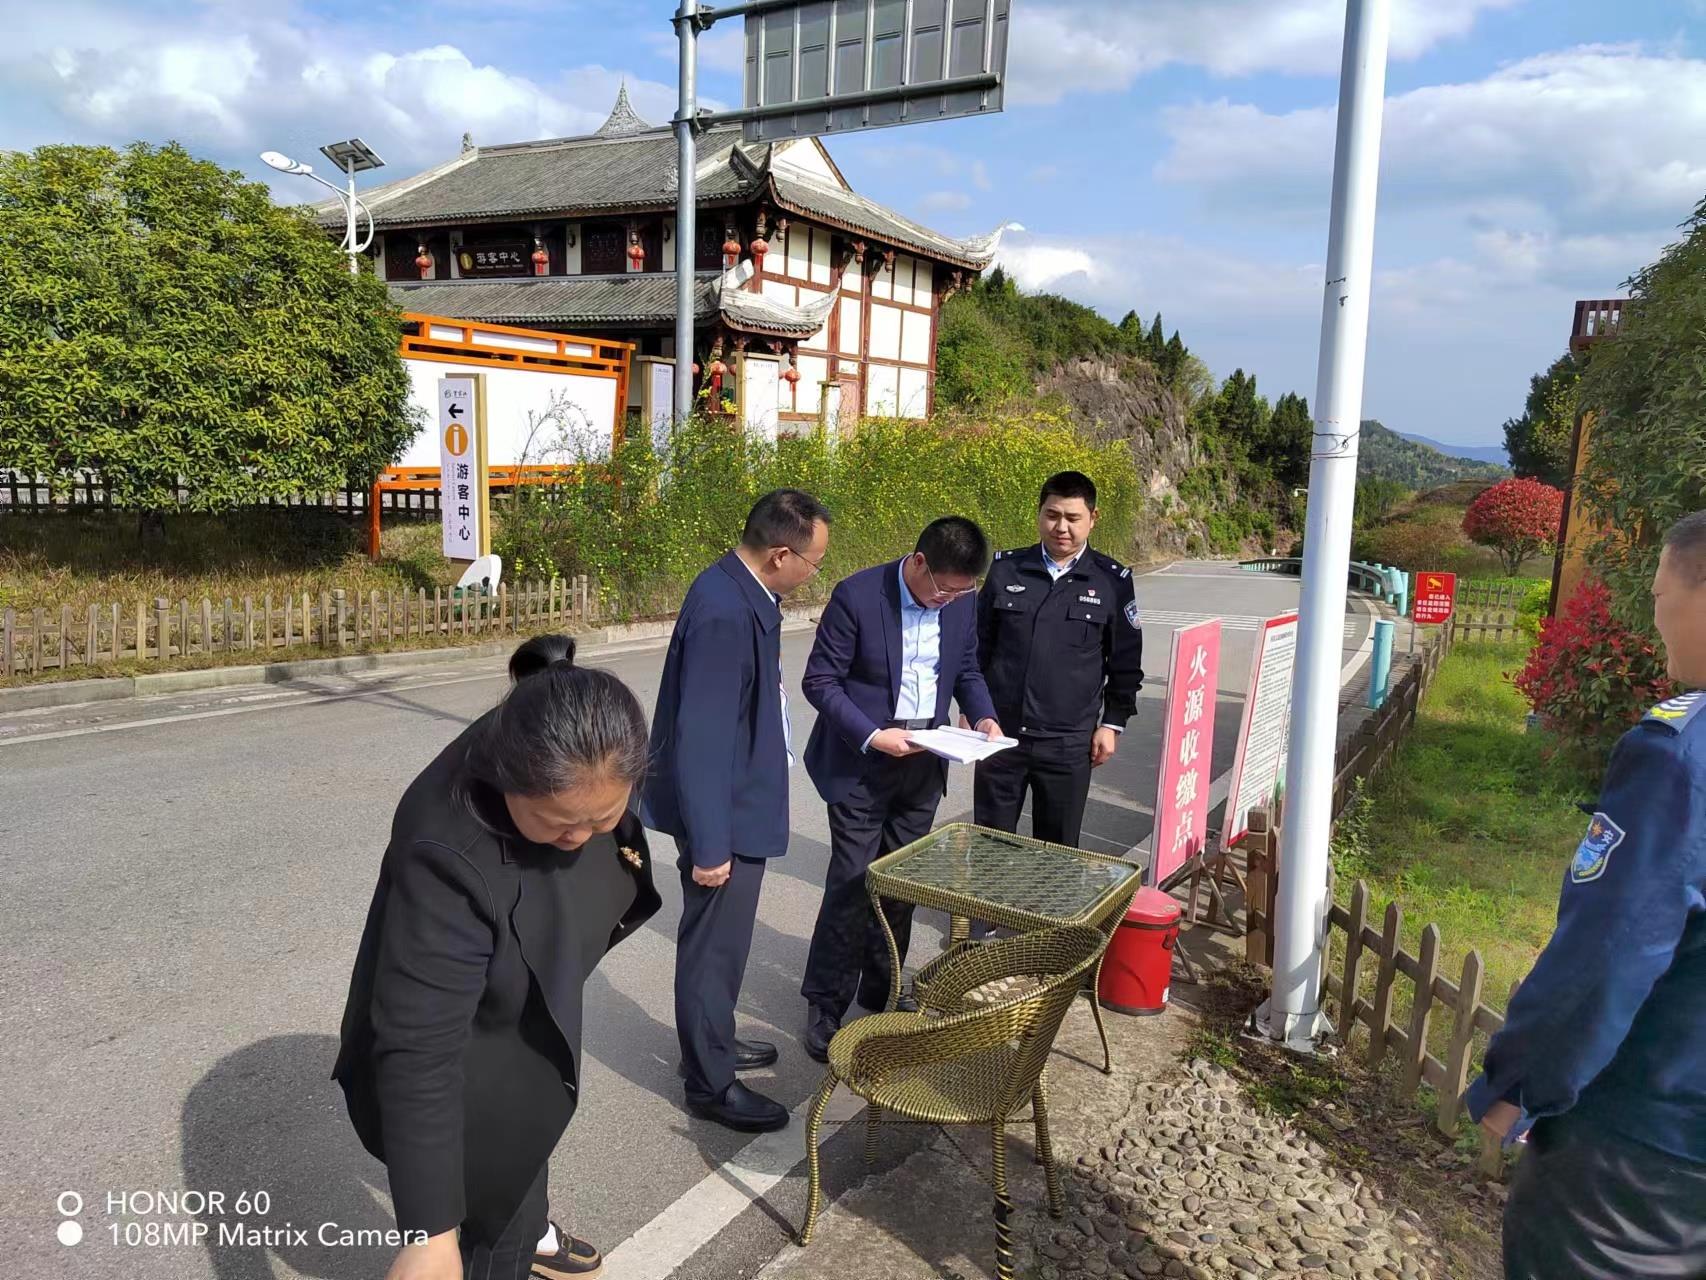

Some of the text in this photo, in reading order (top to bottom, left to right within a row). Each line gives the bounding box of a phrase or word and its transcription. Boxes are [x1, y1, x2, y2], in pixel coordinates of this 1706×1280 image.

[457, 463, 471, 541] 游客中心
[1171, 644, 1208, 854] 火源收缴点
